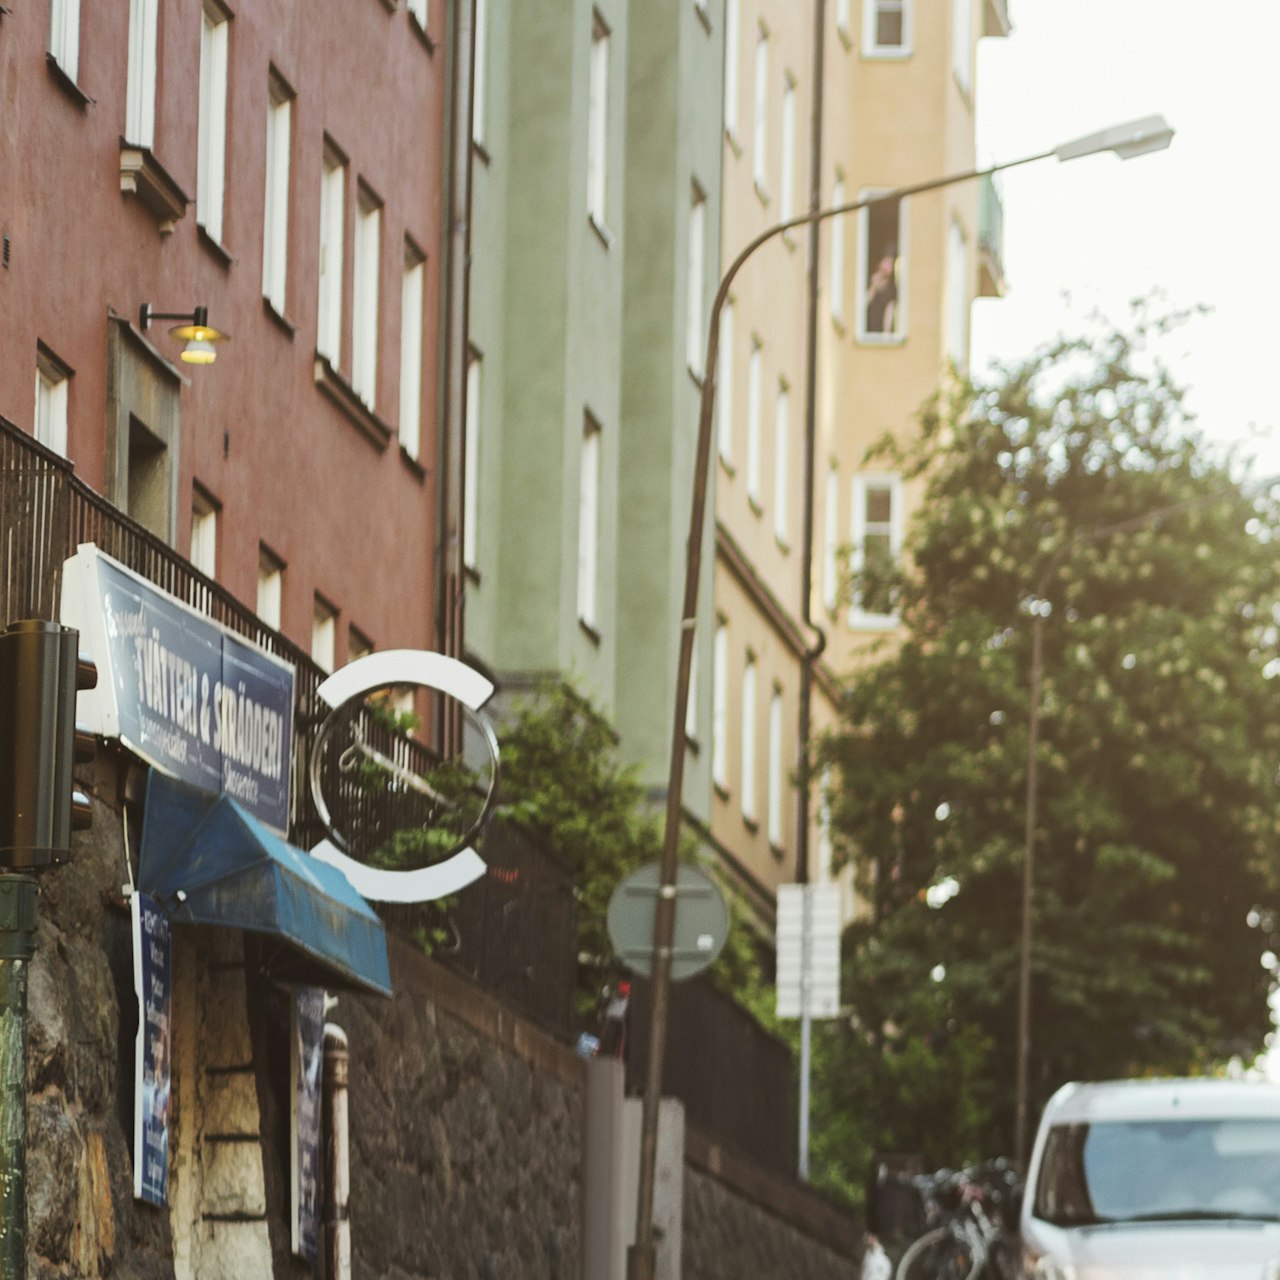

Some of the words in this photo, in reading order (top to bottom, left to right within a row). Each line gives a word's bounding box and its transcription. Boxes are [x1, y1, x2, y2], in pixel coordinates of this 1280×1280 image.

[135, 627, 198, 737] TVÄTTERI
[200, 672, 210, 746] &
[213, 681, 283, 782] SKRÄDDERI
